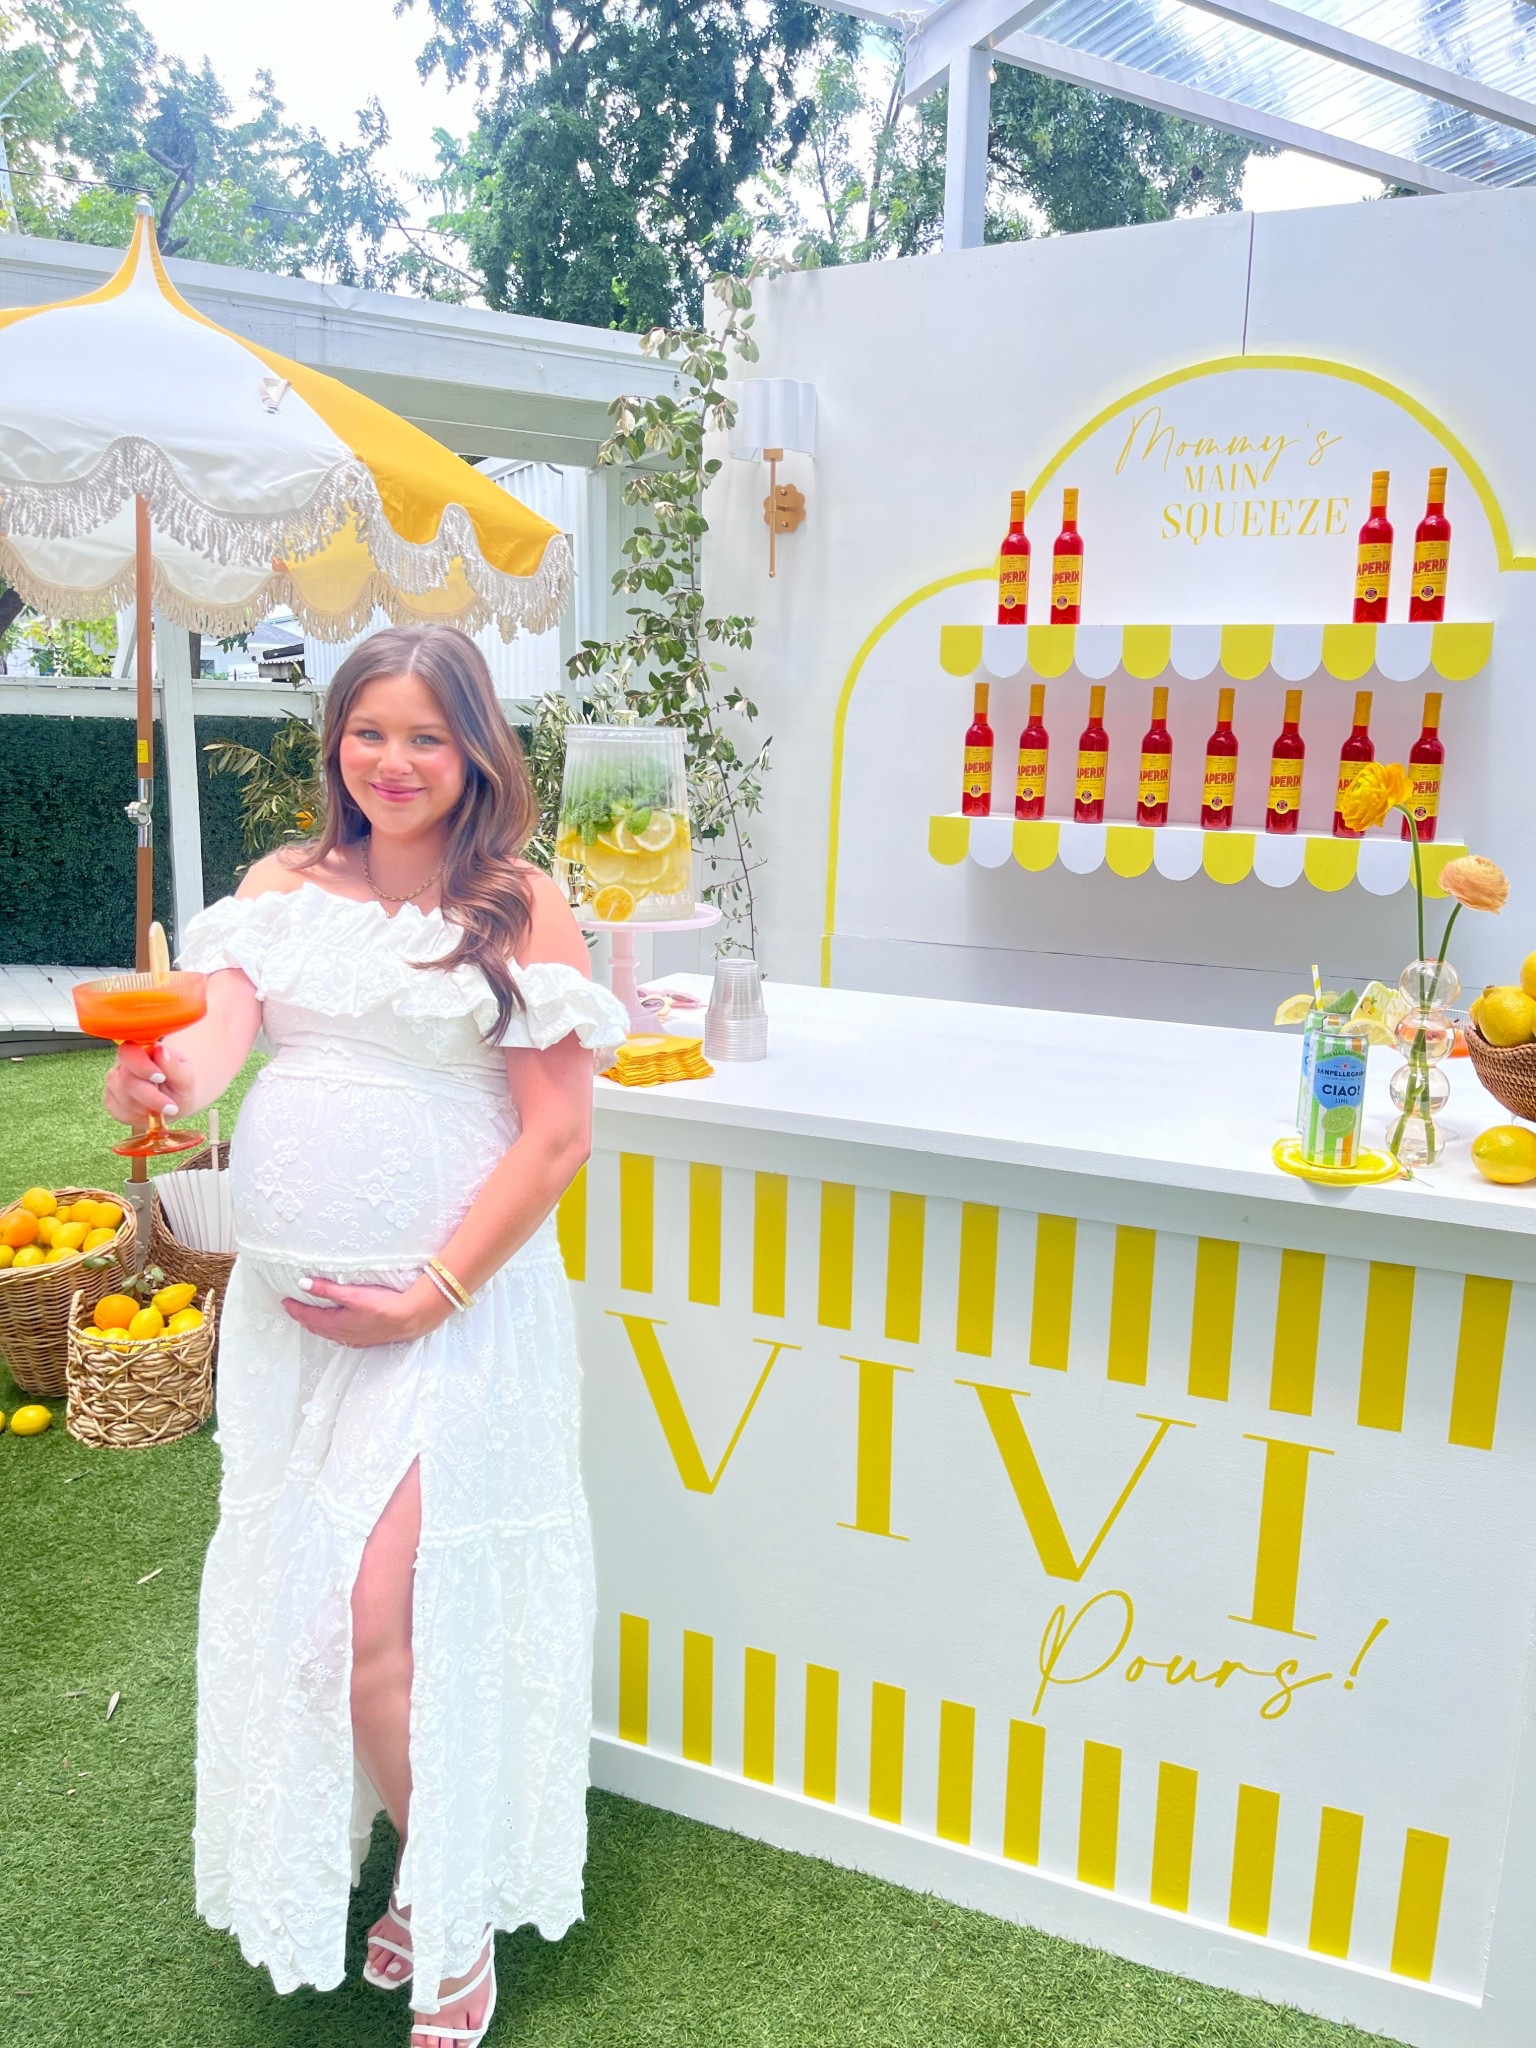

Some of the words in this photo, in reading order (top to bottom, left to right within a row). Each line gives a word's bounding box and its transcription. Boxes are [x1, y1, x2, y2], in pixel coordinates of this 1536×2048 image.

[1115, 406, 1344, 483] Mommy's
[1183, 462, 1259, 493] MAIN
[1161, 496, 1350, 546] SQUEEZE
[1356, 560, 1391, 577] APERIX
[1412, 557, 1448, 575] APERIX
[1204, 771, 1235, 785] APERIX
[1270, 774, 1301, 788] APERIX
[1412, 780, 1440, 794] PERIX
[1322, 1084, 1361, 1096] CIAO!
[604, 1309, 1336, 1640] VIVI
[1031, 1589, 1390, 1719] Pours!
